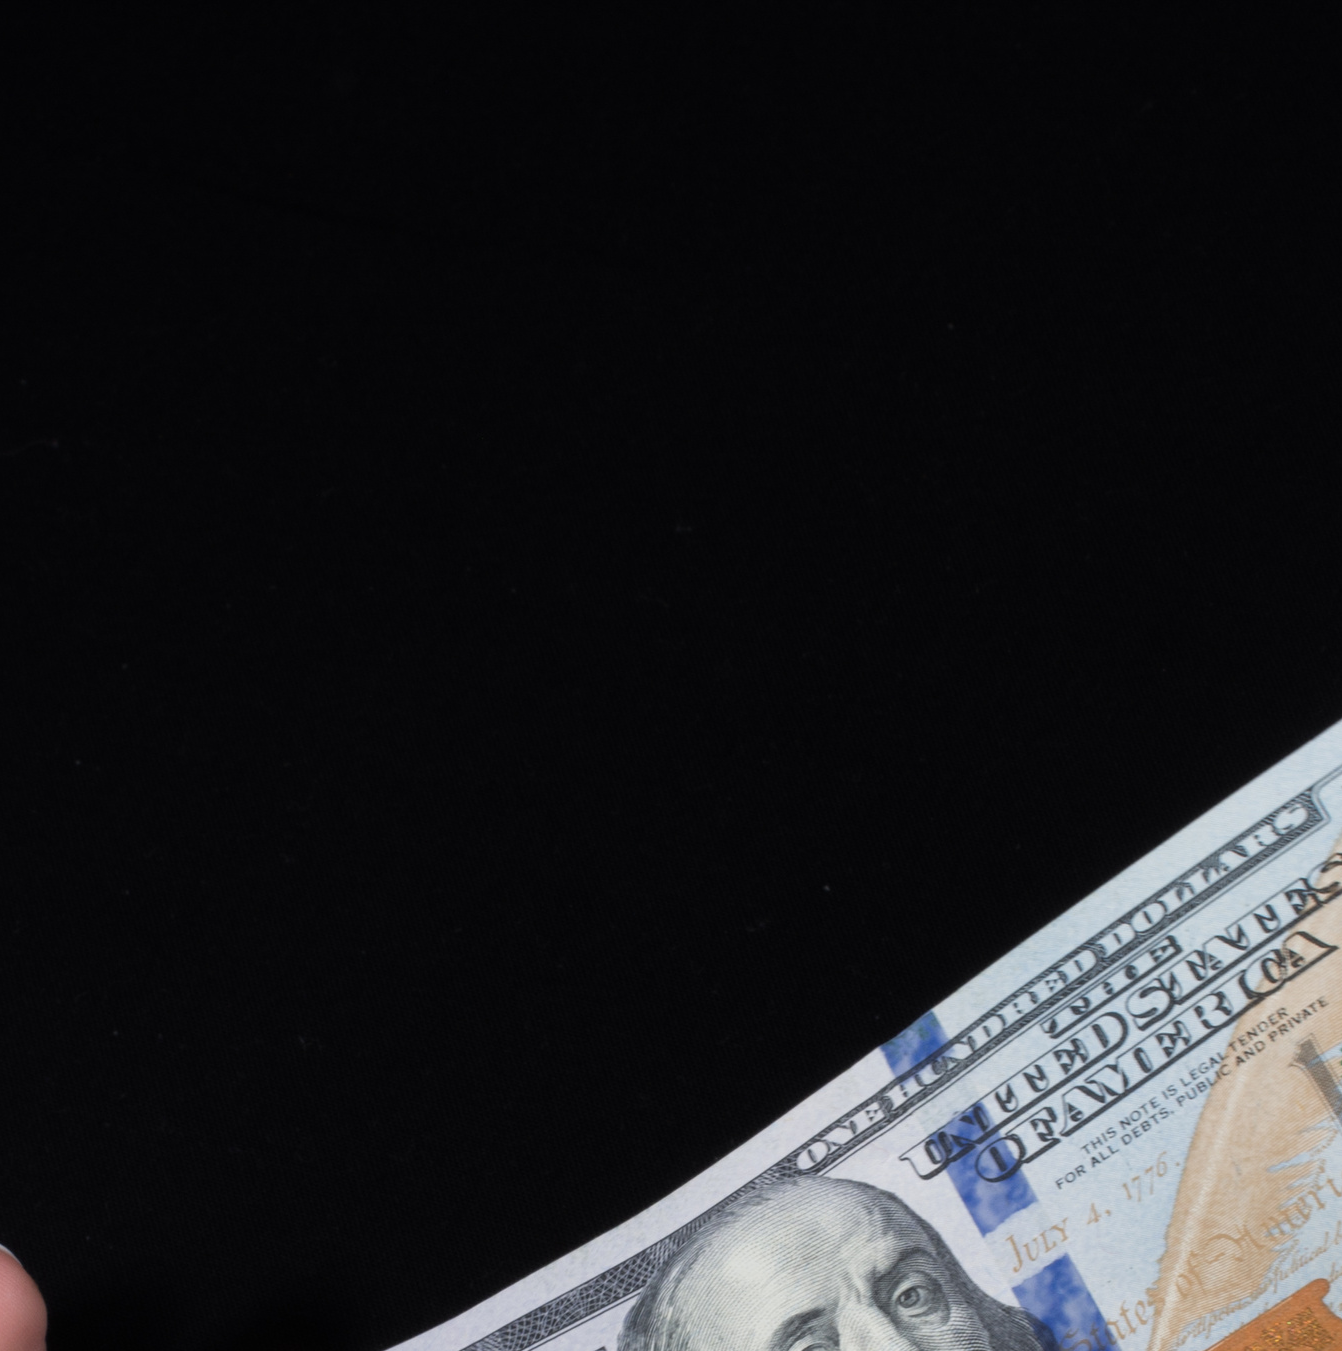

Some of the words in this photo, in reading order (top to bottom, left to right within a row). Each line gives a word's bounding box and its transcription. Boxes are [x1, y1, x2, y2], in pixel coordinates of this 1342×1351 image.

[796, 1099, 890, 1170] ONE
[891, 945, 1101, 1110] HUNDRED
[1099, 803, 1309, 955] DOLLARS
[975, 1106, 1061, 1182] OF
[1060, 931, 1339, 1137] AMERICA
[1040, 935, 1182, 1039] THE
[899, 1012, 1128, 1180] UNITED
[1055, 1165, 1087, 1189] FOR
[1091, 1146, 1120, 1168] ALL
[1176, 1064, 1233, 1107] PUBLIC
[1234, 1041, 1266, 1067] AND
[1268, 995, 1329, 1043] PRIVATE
[1081, 1127, 1117, 1156] THIS
[1119, 1098, 1161, 1130] NOTE
[1161, 1085, 1178, 1100] IS
[1179, 1052, 1227, 1088] LEGAL
[1227, 1007, 1289, 1052] TENDER
